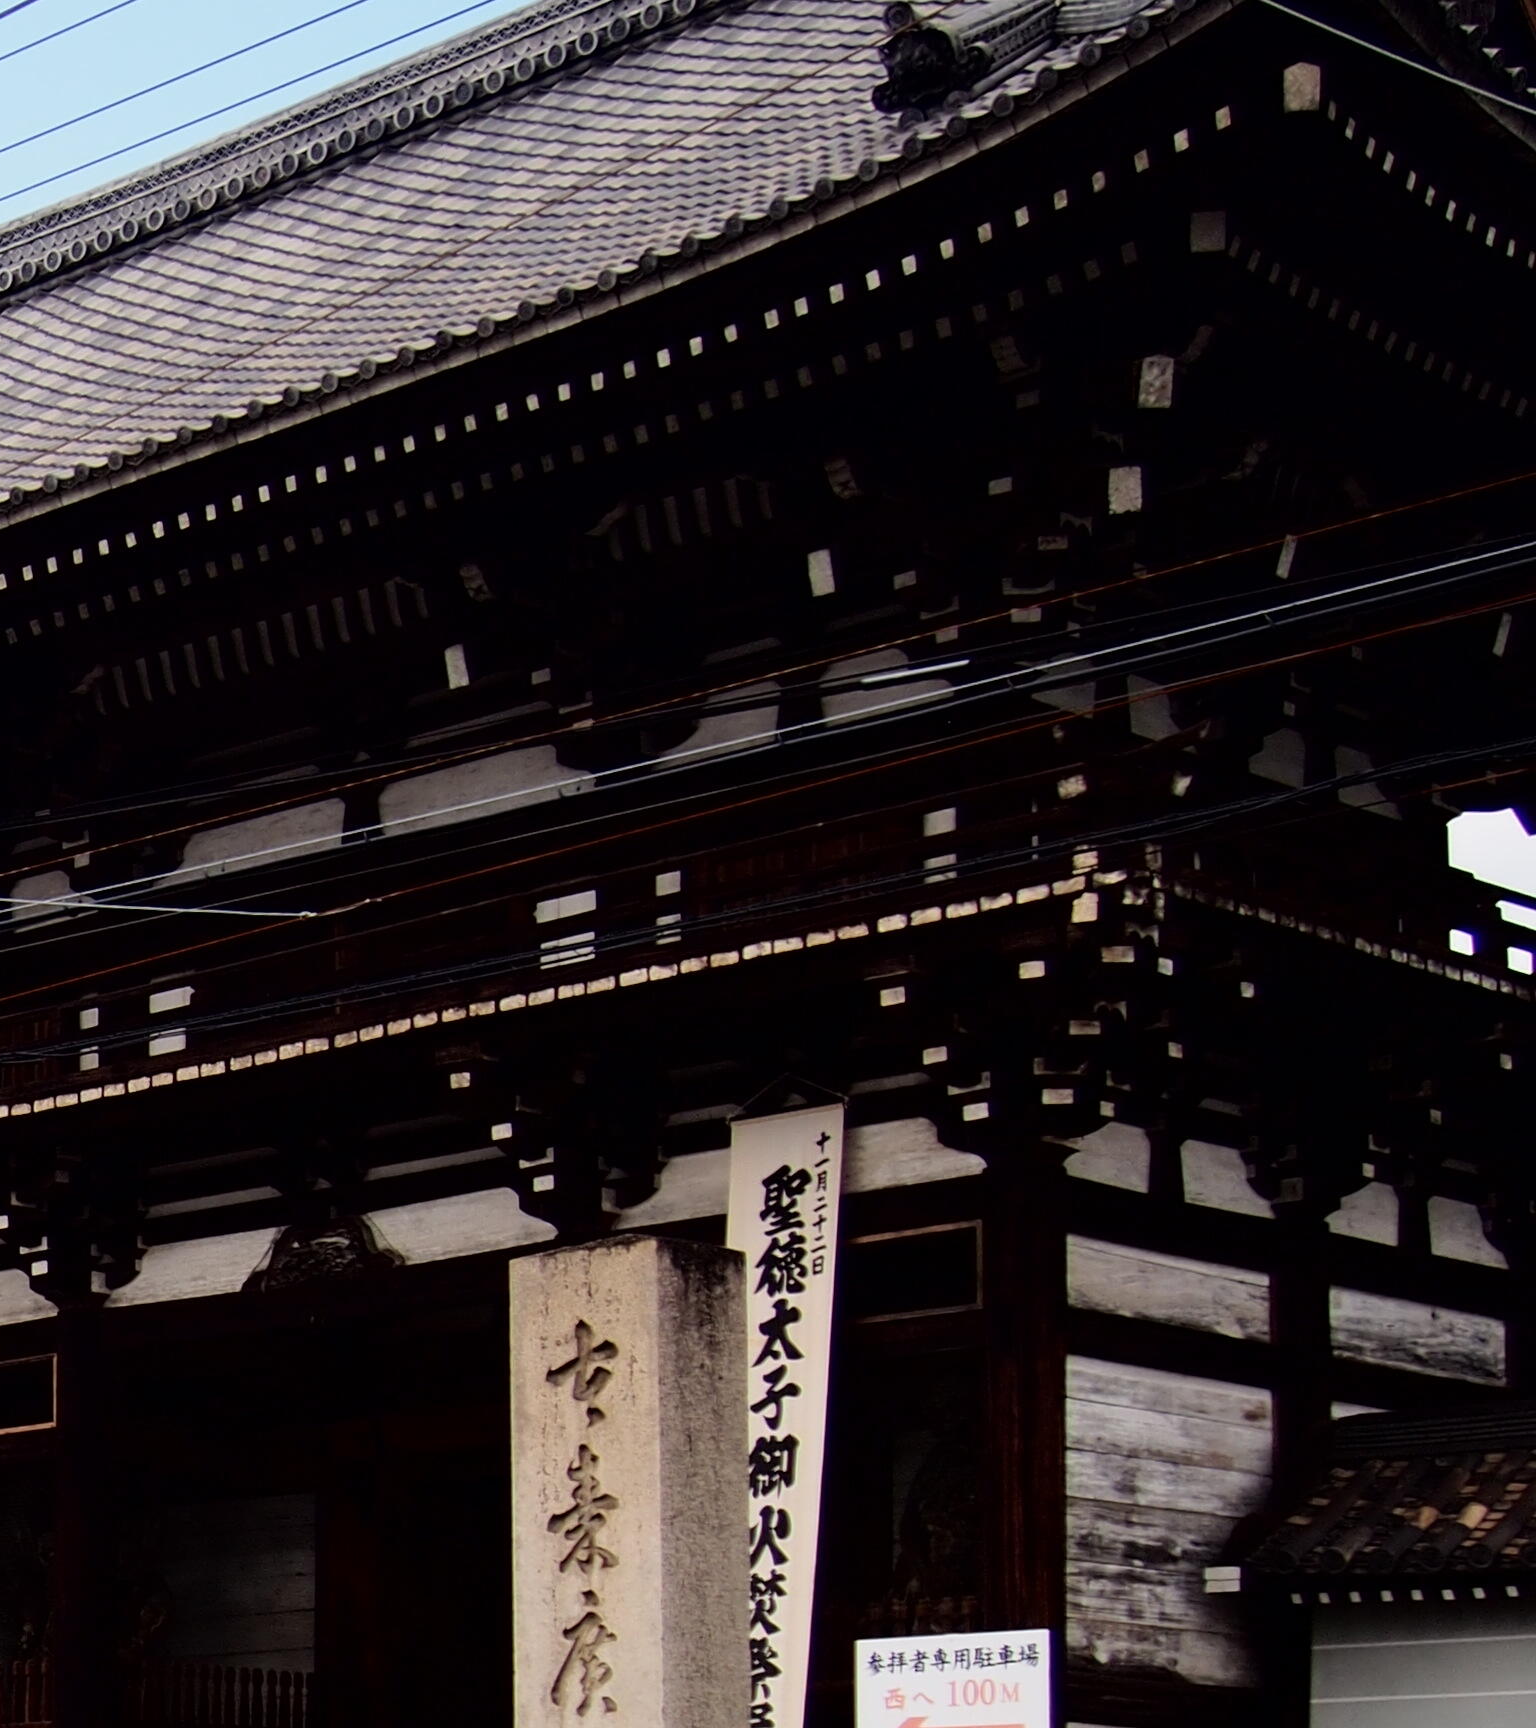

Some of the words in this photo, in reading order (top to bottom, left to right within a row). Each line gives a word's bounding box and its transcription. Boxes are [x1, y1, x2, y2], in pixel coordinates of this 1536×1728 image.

[810, 1131, 831, 1276] 十一月二十二日
[867, 1643, 1041, 1675] 参拝者専用駐車場
[885, 1688, 935, 1710] 西へ
